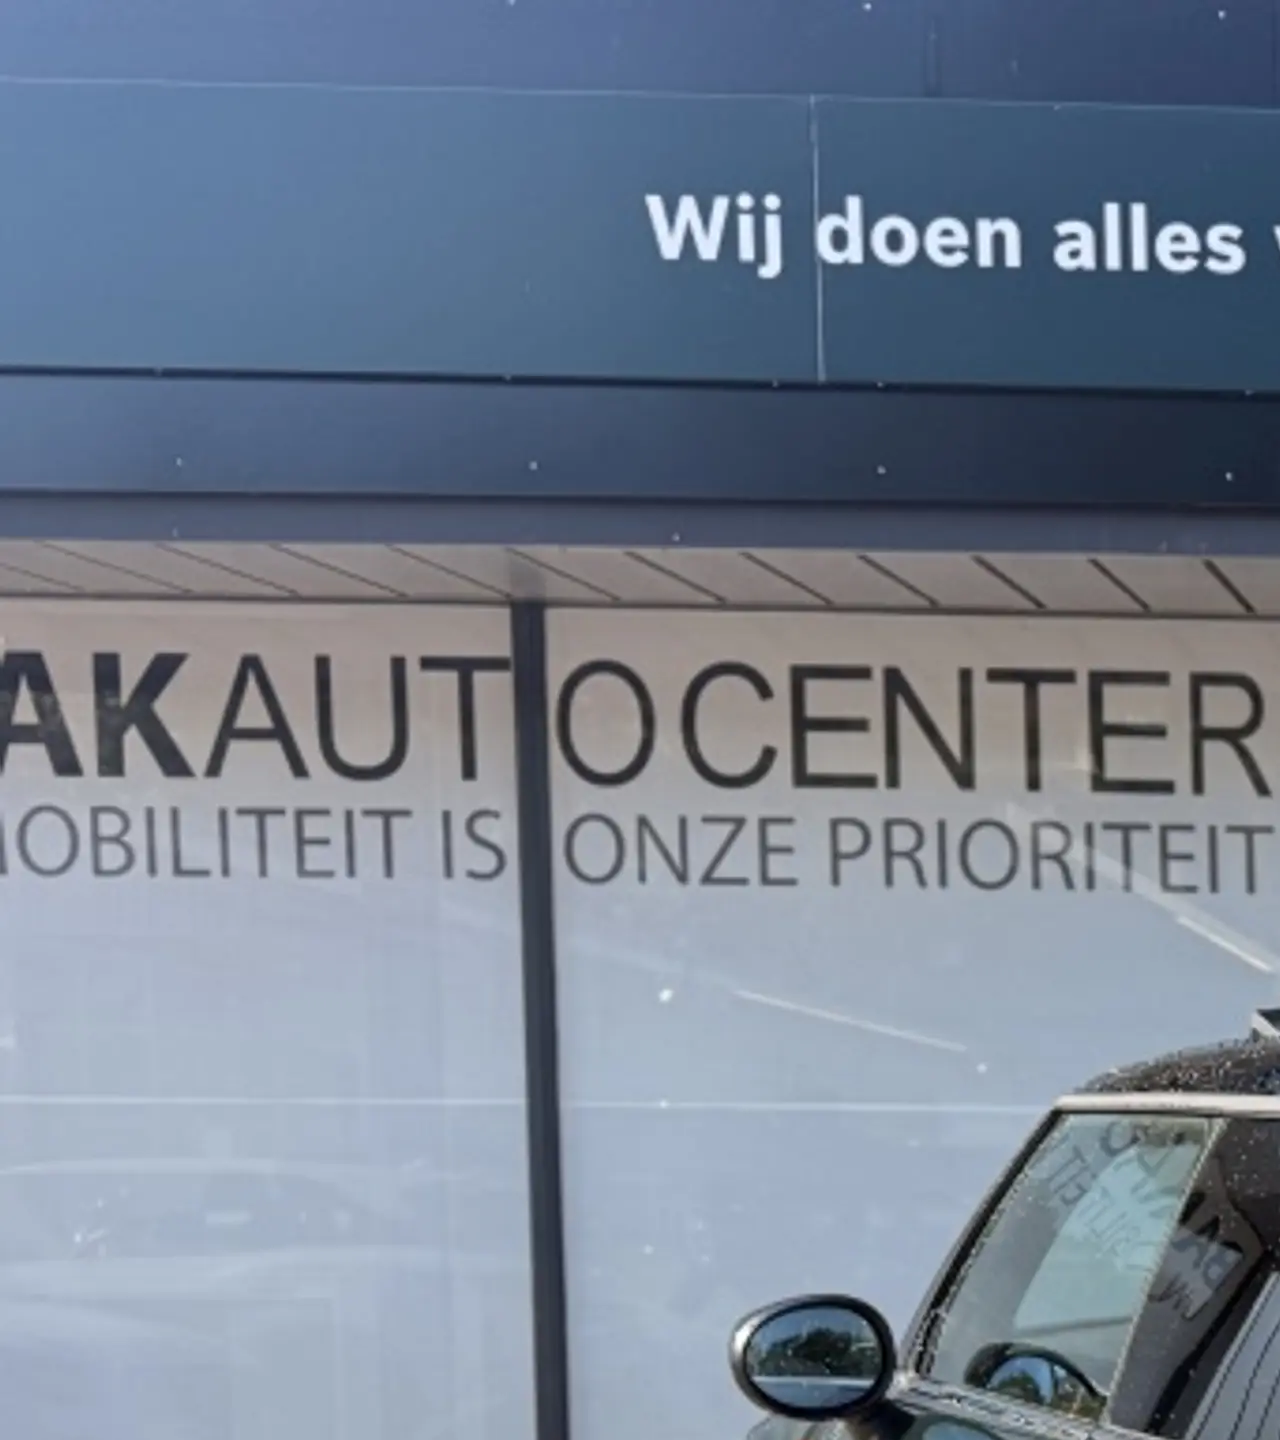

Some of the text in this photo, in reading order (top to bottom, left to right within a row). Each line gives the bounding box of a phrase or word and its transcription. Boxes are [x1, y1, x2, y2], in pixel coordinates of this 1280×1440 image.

[645, 191, 783, 279] Wij
[814, 195, 1022, 268] doen
[1052, 201, 1247, 274] alles
[0, 804, 1276, 896] OBILITEIT IS ONZE PRIORITEIT
